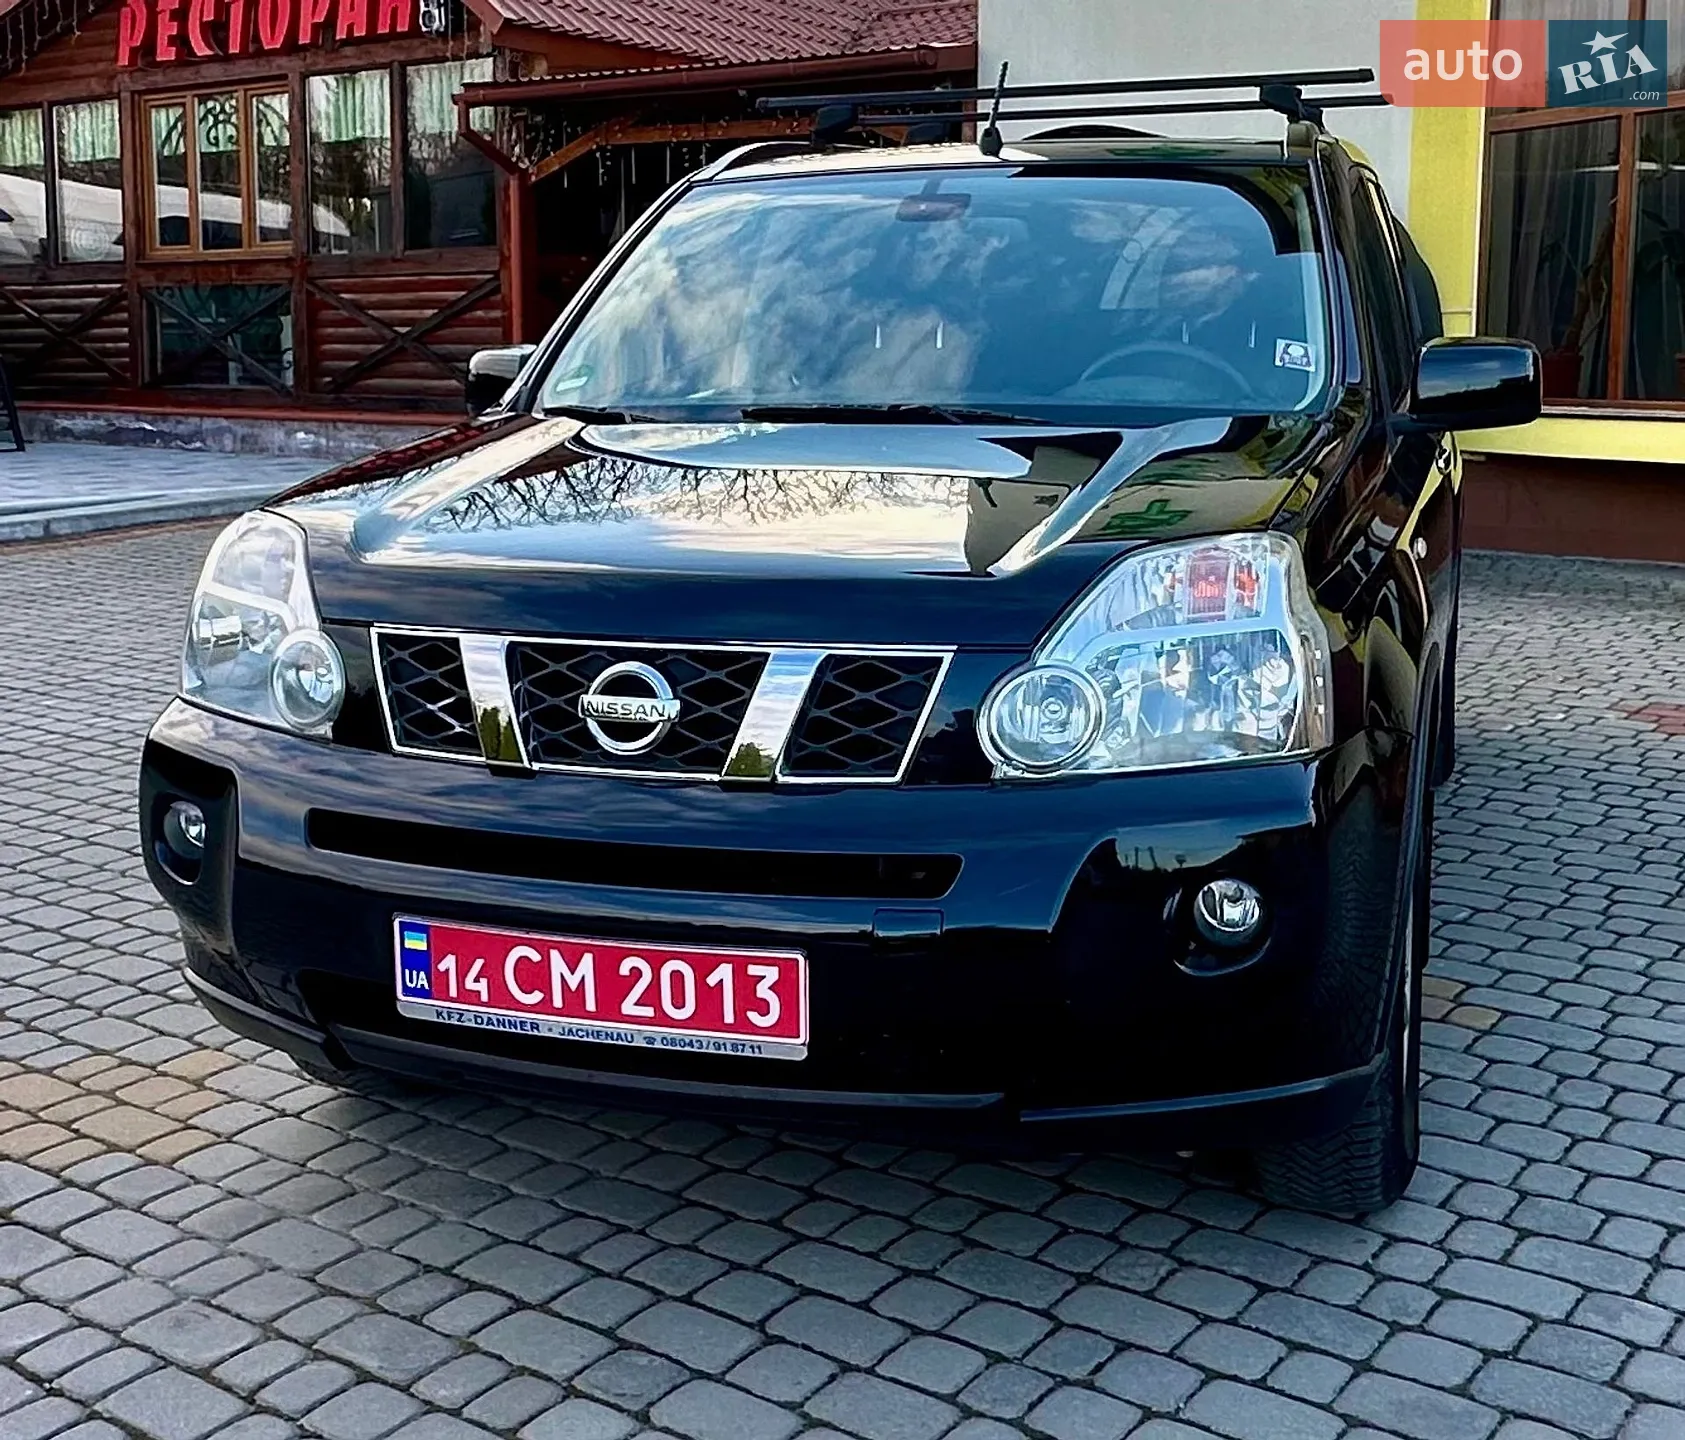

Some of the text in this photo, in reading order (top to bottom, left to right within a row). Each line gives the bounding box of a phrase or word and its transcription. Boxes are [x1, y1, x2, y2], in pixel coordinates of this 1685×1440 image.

[586, 700, 666, 717] NISSAN
[405, 968, 430, 990] UA
[437, 945, 781, 1028] 14 CM 2013
[558, 1026, 635, 1043] JACHENAU
